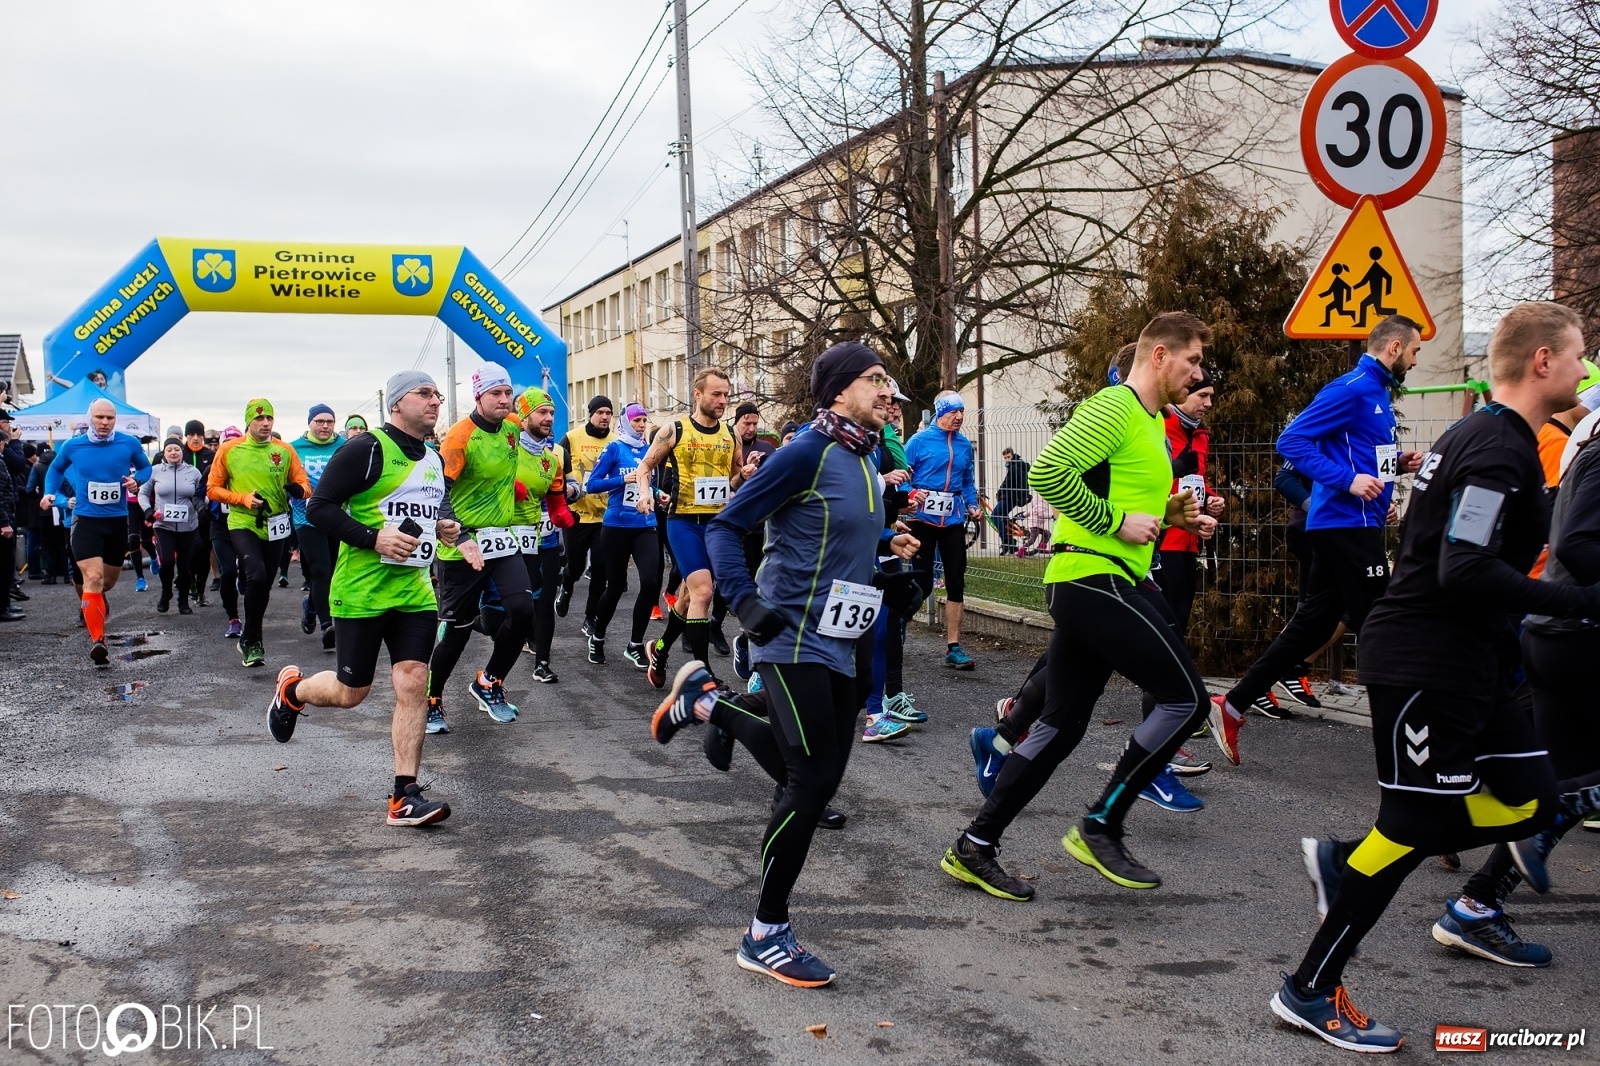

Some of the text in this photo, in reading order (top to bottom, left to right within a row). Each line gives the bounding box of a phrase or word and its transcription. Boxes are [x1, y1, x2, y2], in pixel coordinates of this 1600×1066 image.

[1325, 90, 1423, 170] 30
[275, 250, 355, 264] Gmina
[254, 265, 376, 282] Pietrowice
[270, 283, 361, 298] Wielkie
[73, 262, 160, 340] Gmina ludzi
[464, 272, 542, 347] Gmina ludzi
[94, 282, 174, 354] aktywnych
[451, 289, 525, 360] aktywnych
[90, 490, 119, 500] 186
[698, 486, 727, 499] 171
[926, 499, 952, 512] 214
[165, 510, 187, 519] 227
[481, 536, 517, 554] 282
[1366, 565, 1384, 577] 18
[830, 602, 875, 630] 139
